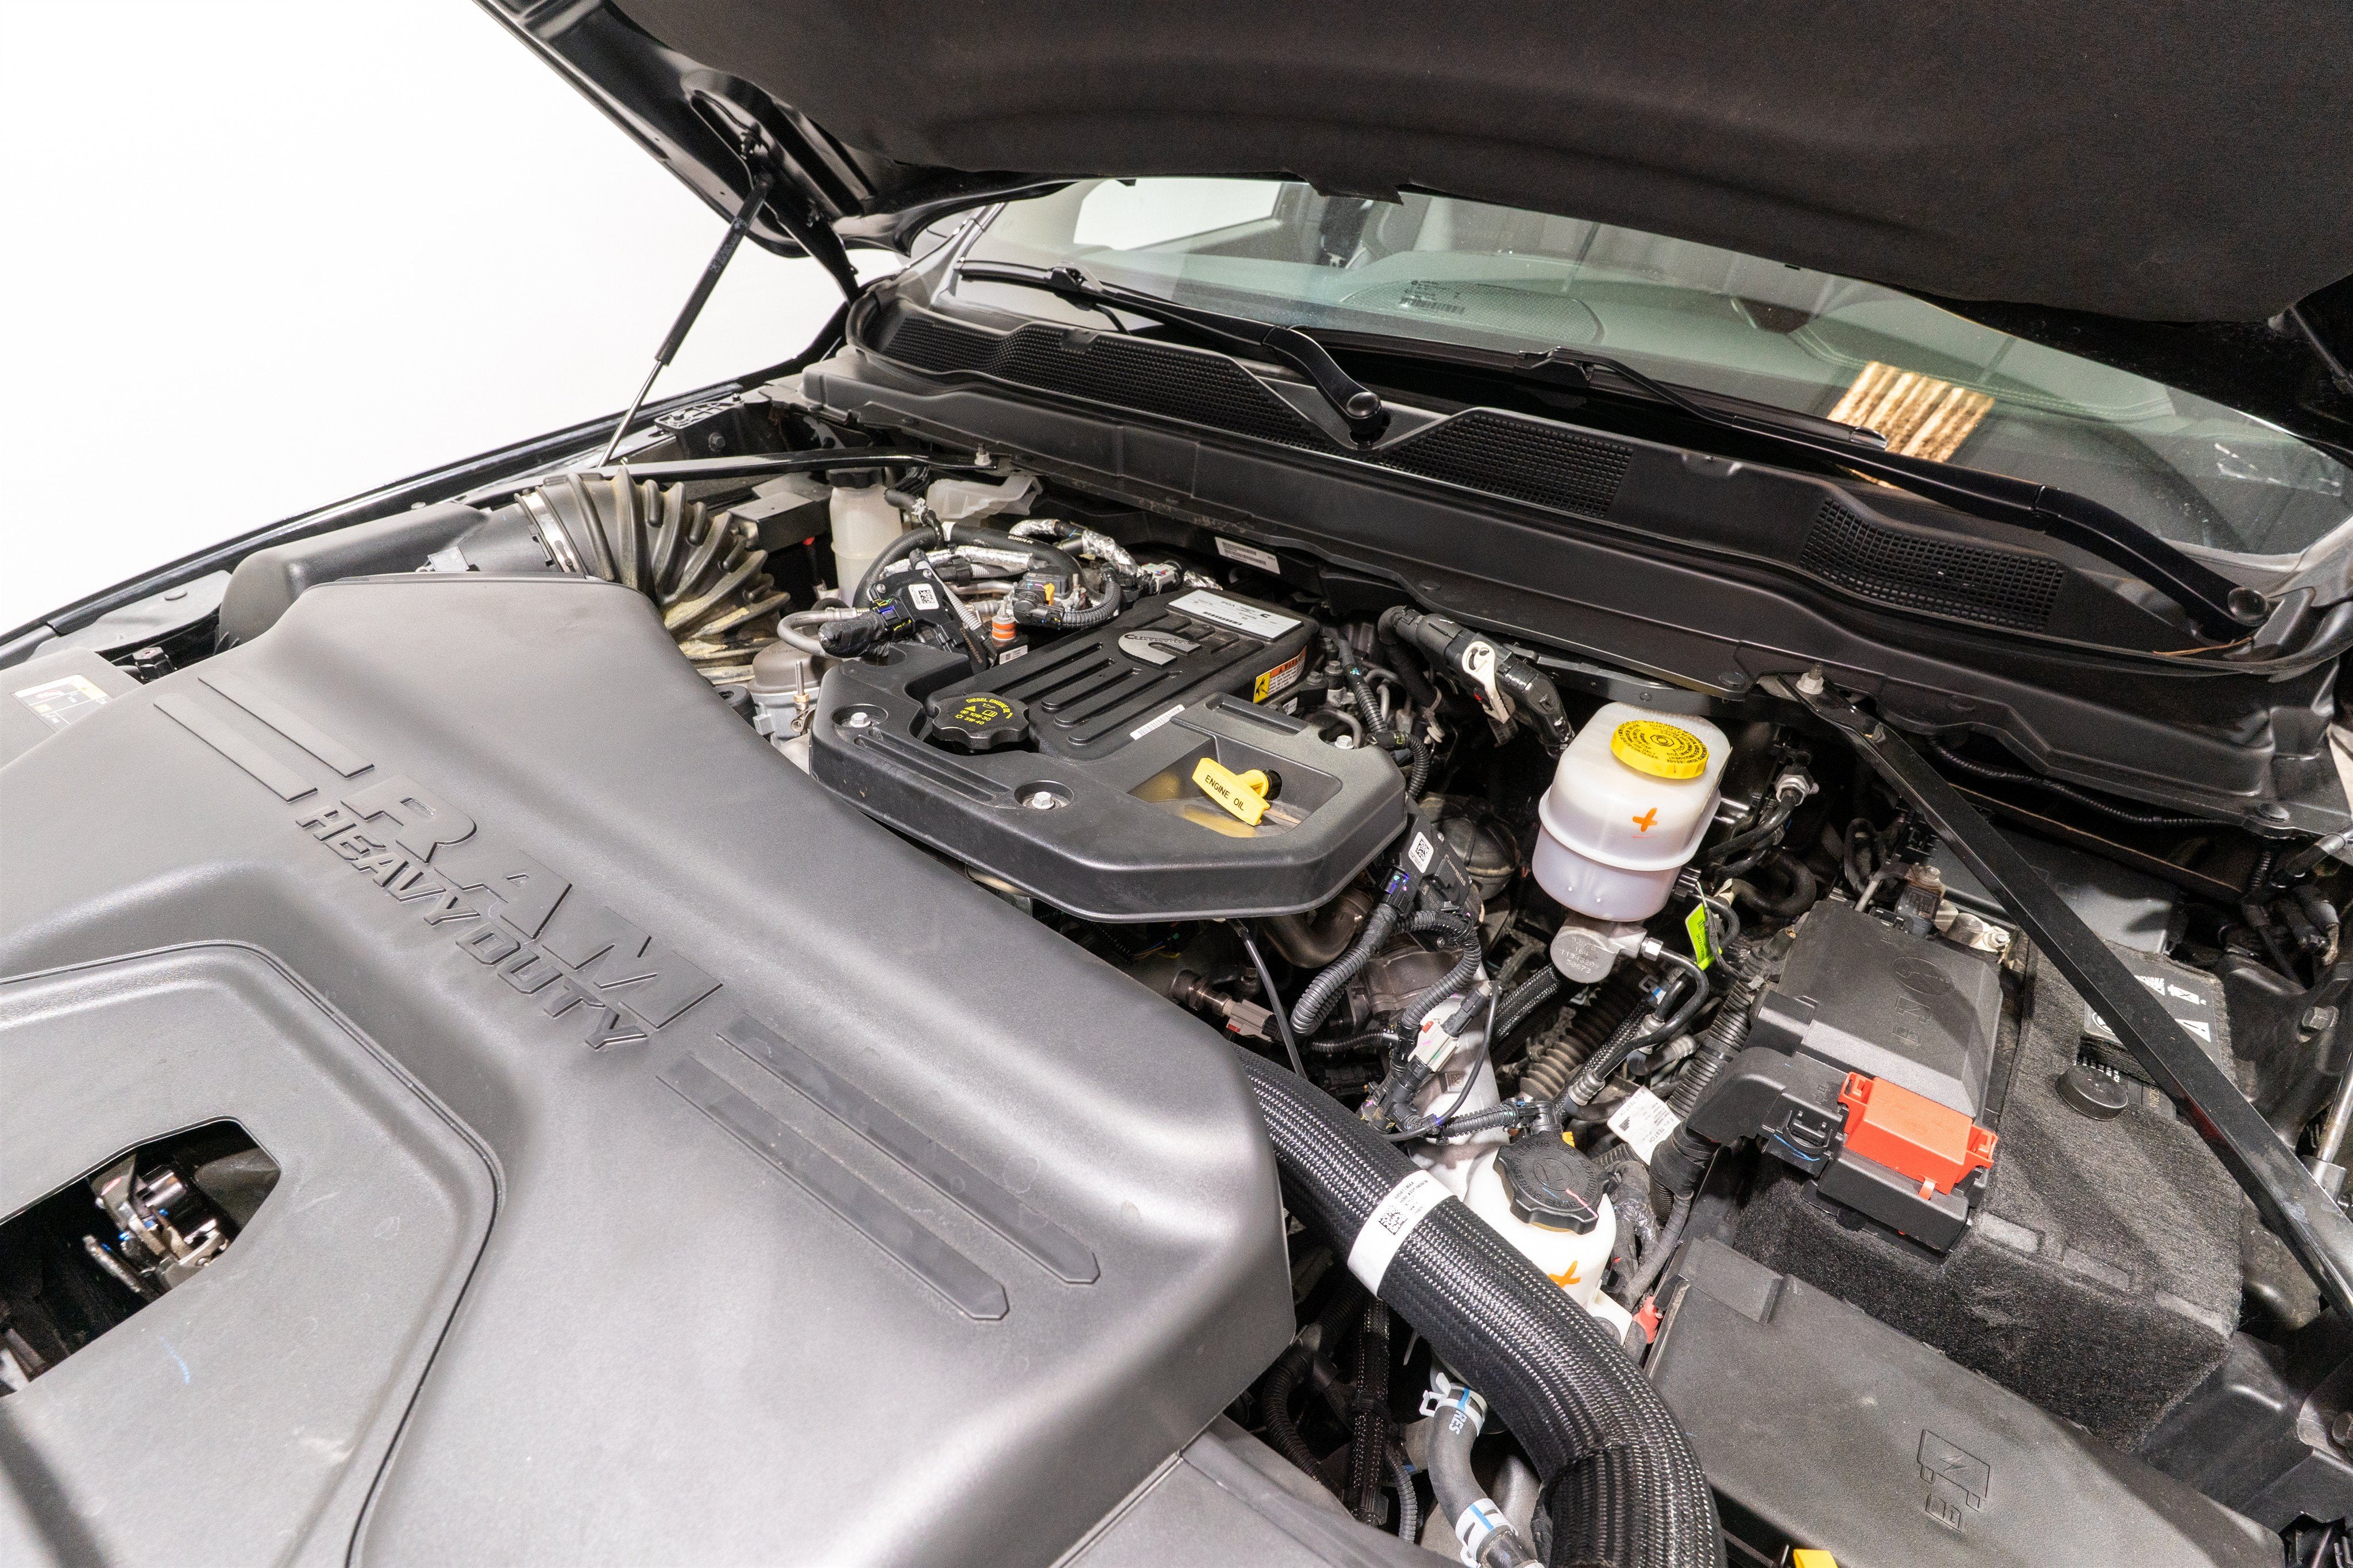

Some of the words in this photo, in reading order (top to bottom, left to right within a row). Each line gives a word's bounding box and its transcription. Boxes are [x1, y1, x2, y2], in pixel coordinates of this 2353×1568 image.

[959, 627, 983, 663] Cummins
[969, 712, 992, 721] 10W-30
[989, 698, 1009, 709] ENGINE
[964, 717, 985, 725] 5W-40
[1205, 775, 1230, 799] ENGINE
[1233, 798, 1244, 811] OIL
[1444, 854, 1467, 886] Cummins
[341, 774, 723, 1029] RAM
[296, 805, 480, 926] HEAVY
[456, 922, 648, 1051] DUTY
[1625, 1099, 1635, 1110] TEST
[1653, 1126, 1665, 1138] TEST
[1557, 1146, 1578, 1158] USE
[1579, 1158, 1598, 1204] APPROVED
[1449, 1409, 1467, 1435] RES
